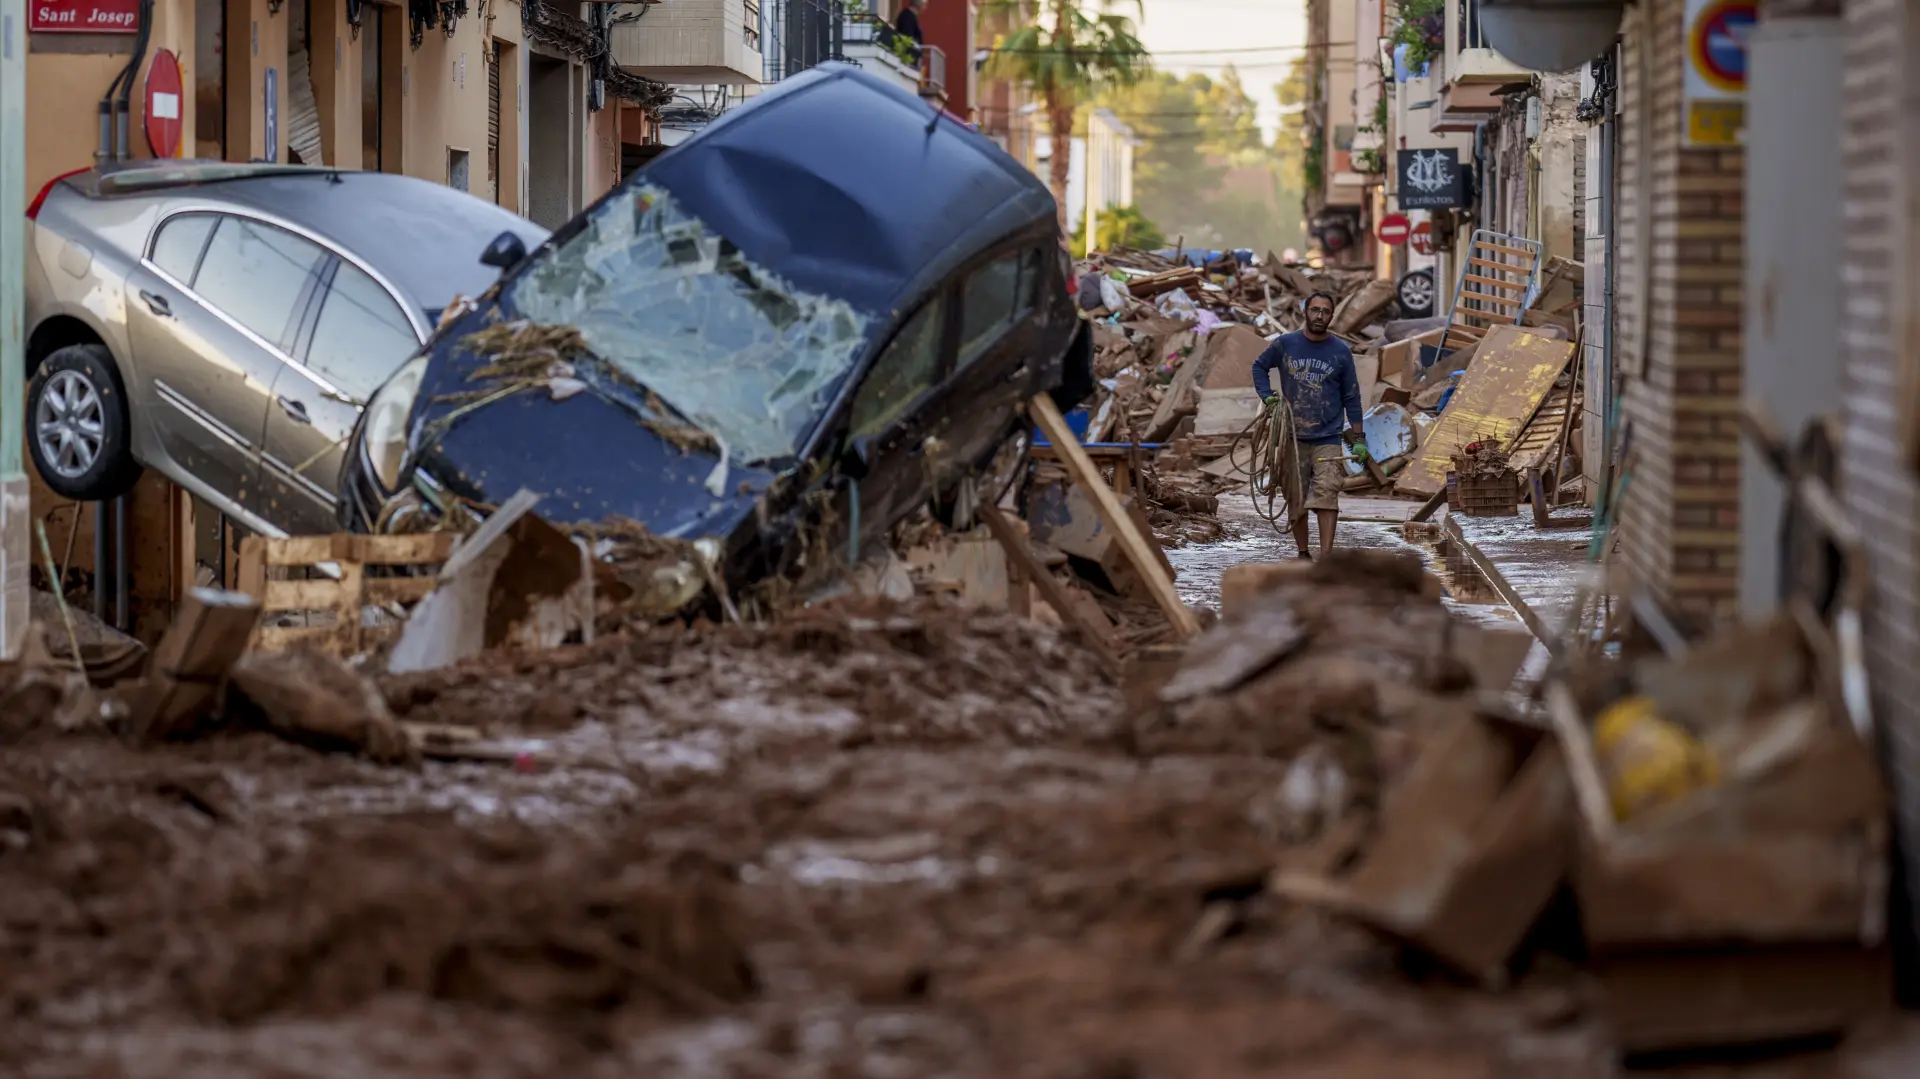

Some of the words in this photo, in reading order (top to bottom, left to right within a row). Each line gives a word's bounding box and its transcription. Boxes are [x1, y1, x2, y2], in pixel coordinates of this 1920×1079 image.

[39, 7, 76, 22] Sant
[87, 8, 135, 26] Josep
[1411, 232, 1432, 244] STO
[1288, 357, 1334, 375] DOWNTOWN
[1293, 371, 1324, 382] HIDEOUT
